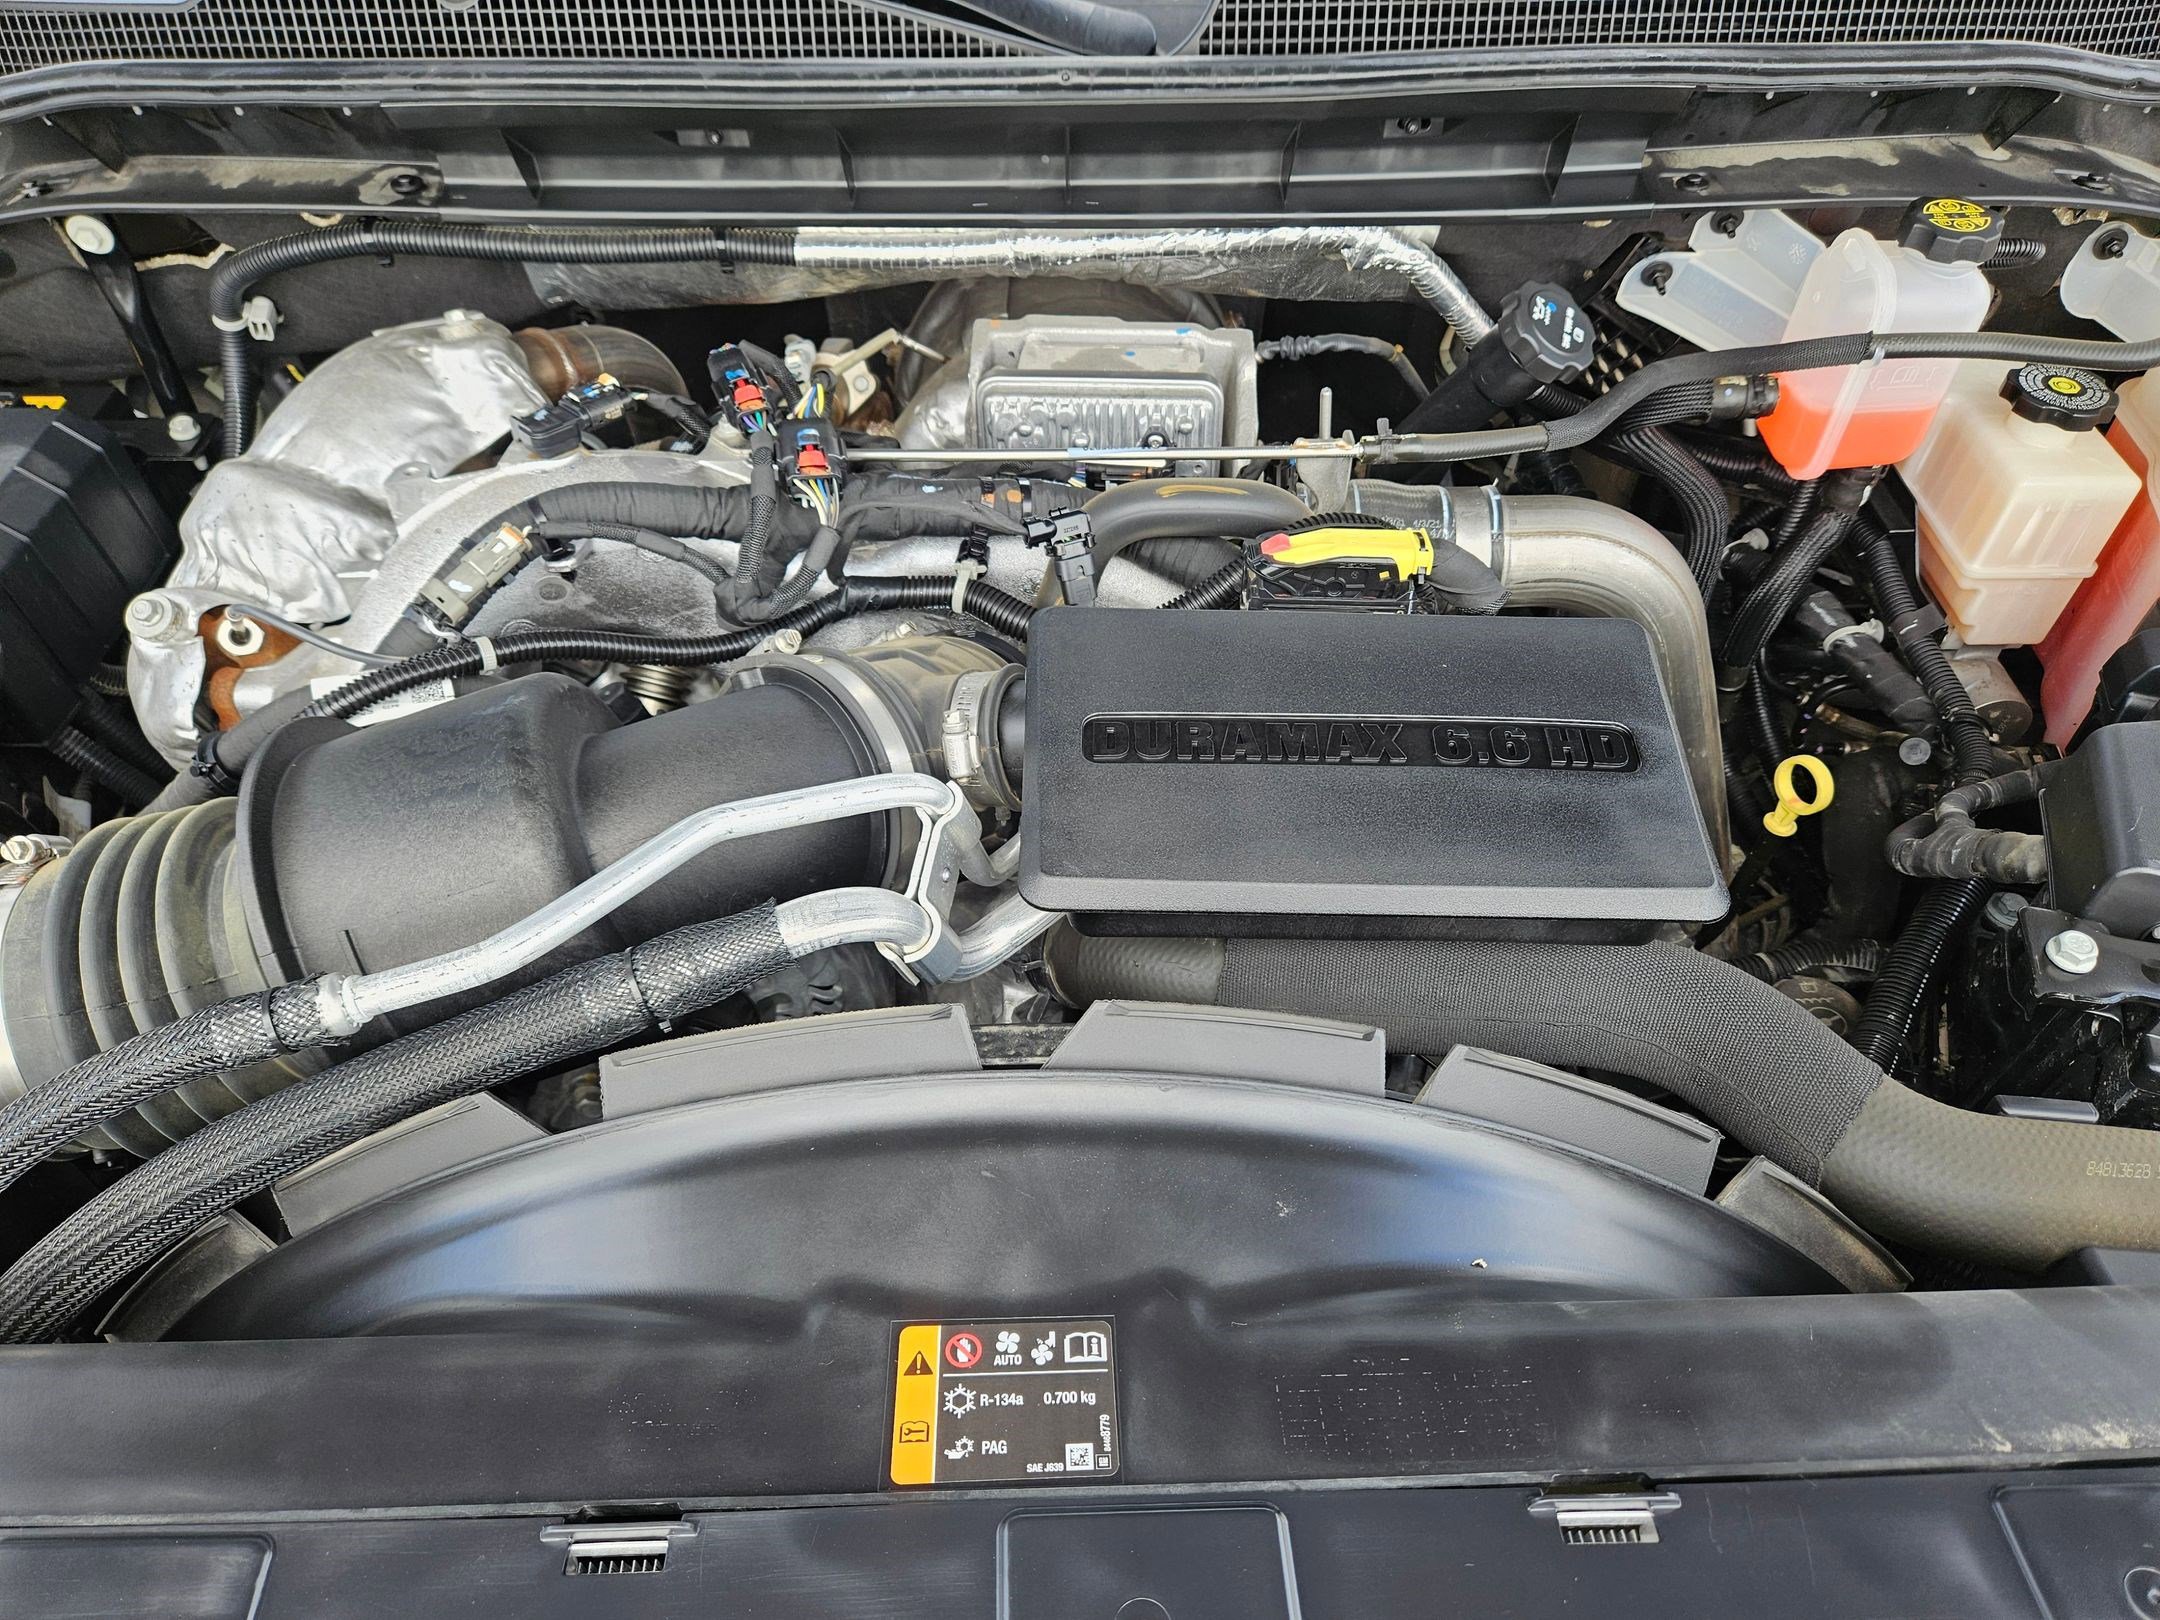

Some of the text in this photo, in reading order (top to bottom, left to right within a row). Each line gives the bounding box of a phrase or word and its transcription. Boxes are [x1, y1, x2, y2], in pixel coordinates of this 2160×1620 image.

[1092, 720, 1630, 768] DURAMAX 6.6 HD
[2086, 1160, 2152, 1179] 84813628
[993, 1354, 1022, 1366] AUTO
[980, 1390, 1097, 1407] R-134a 0.700 kg
[981, 1440, 1008, 1455] PAG
[1026, 1463, 1043, 1473] SAE
